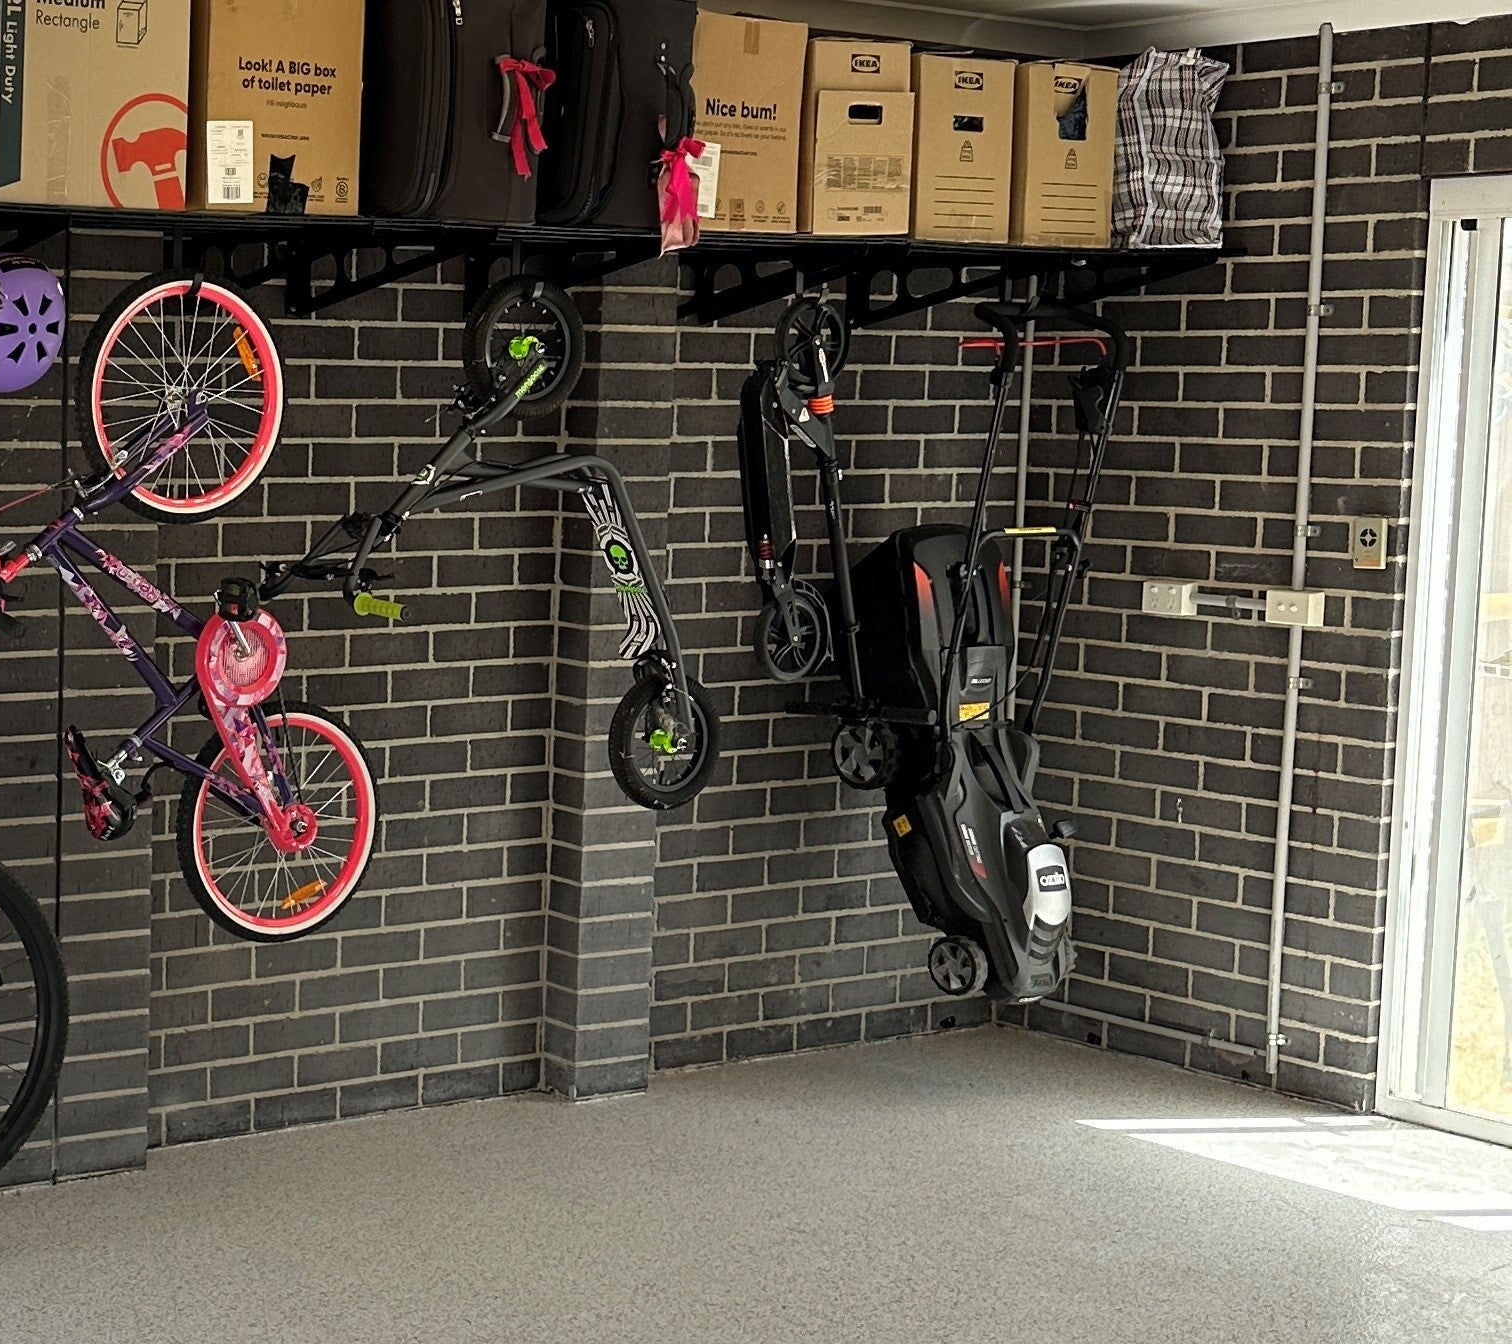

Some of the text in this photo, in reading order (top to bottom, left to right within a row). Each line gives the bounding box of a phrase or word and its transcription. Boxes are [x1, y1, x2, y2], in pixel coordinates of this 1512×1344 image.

[35, 10, 101, 33] Rectangle
[3, 22, 17, 60] Light
[238, 56, 337, 79] Look! A BIG box
[853, 58, 878, 68] IKEA
[1, 64, 16, 104] Duty
[242, 75, 332, 97] of toilet paper
[957, 75, 981, 85] IKEA
[1054, 80, 1078, 90] IKEA
[705, 98, 777, 121] Nice bum!
